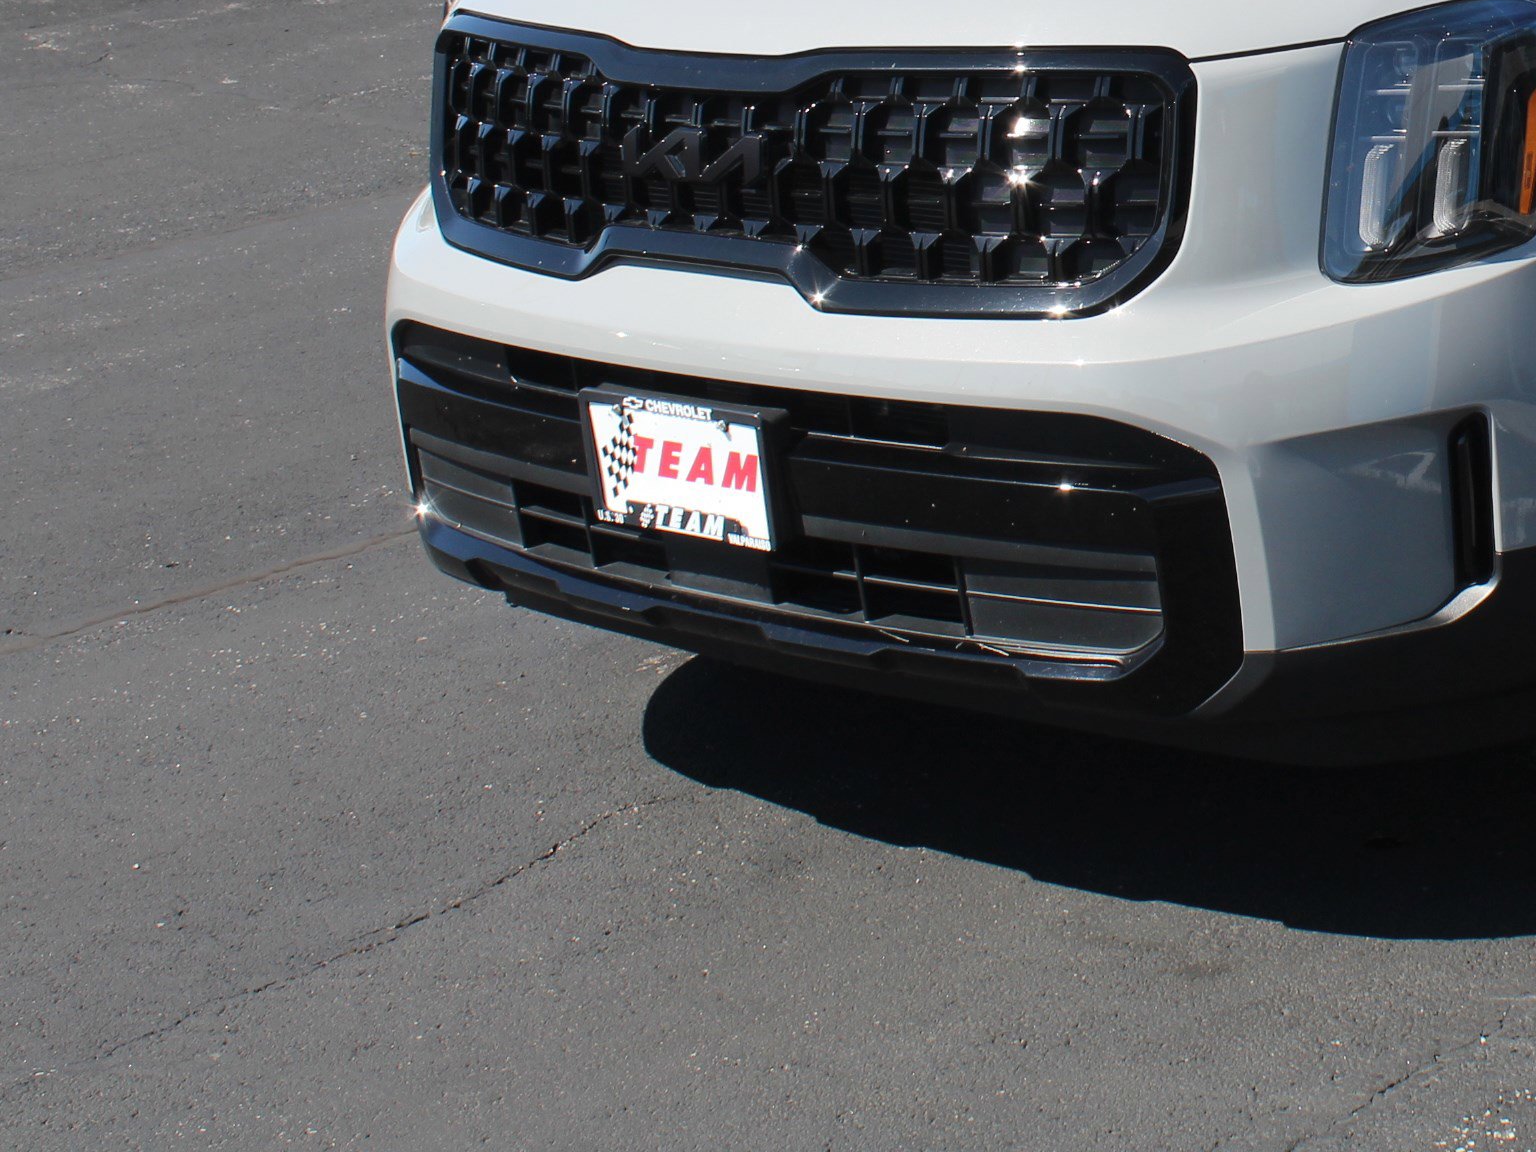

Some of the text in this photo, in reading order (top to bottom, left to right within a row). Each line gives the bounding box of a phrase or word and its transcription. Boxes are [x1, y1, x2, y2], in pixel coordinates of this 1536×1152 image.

[644, 399, 712, 421] CHEVROLET
[633, 434, 758, 493] TEAM
[655, 504, 725, 538] TEAM
